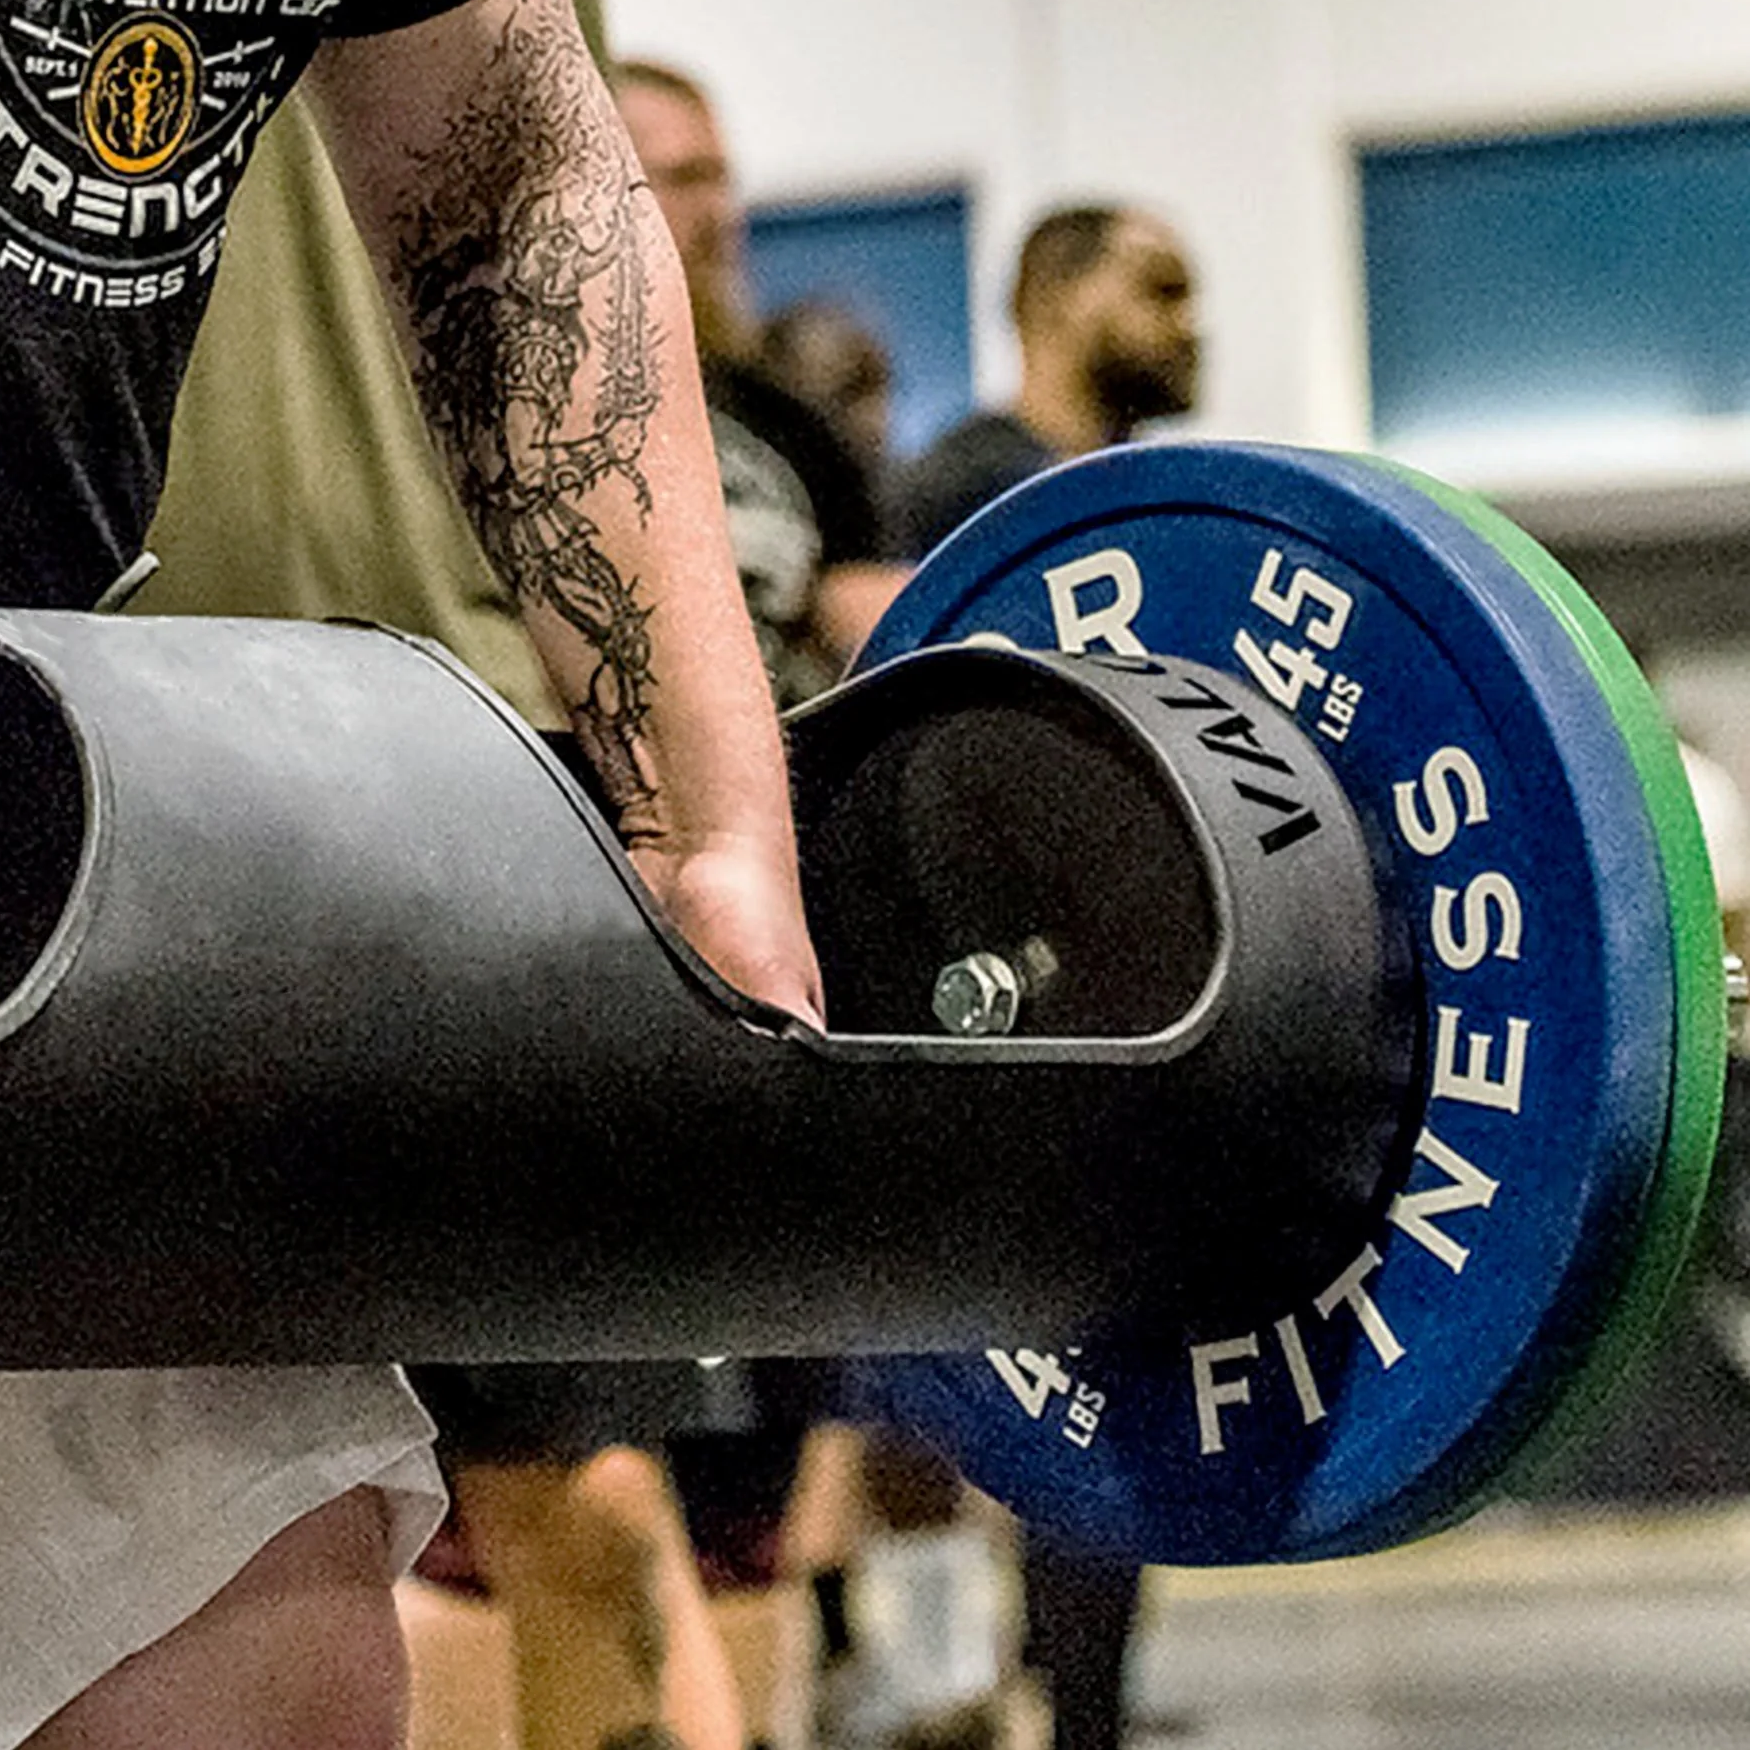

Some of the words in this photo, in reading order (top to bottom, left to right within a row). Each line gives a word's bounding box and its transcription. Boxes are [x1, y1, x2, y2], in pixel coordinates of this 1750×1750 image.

[1232, 547, 1353, 712] 45
[1316, 673, 1365, 744] LBS
[1189, 744, 1530, 1454] FITNESS
[1061, 1381, 1107, 1449] LBS
